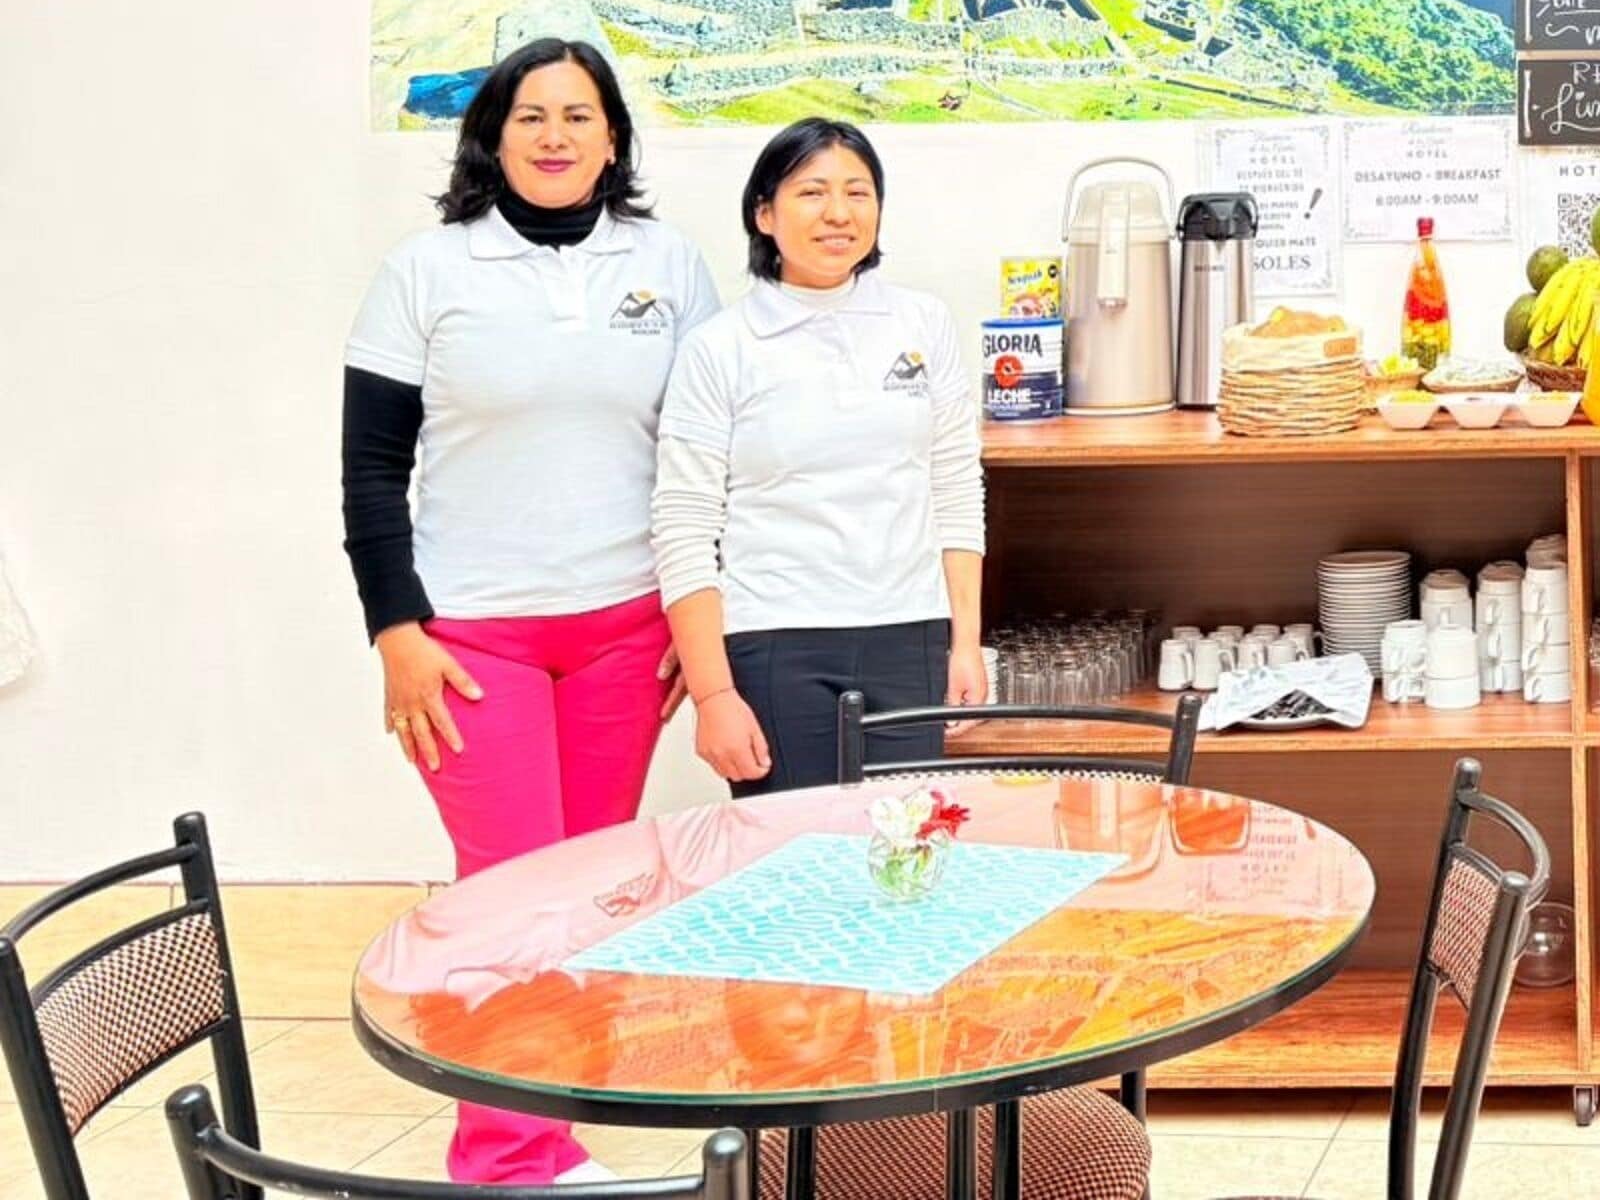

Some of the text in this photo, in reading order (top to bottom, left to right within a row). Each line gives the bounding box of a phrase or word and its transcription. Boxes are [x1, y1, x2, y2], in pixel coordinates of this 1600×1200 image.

[1354, 170, 1423, 183] DESAYUNO
[1434, 168, 1502, 181] BREAKFAST
[982, 333, 1043, 357] GLORIA
